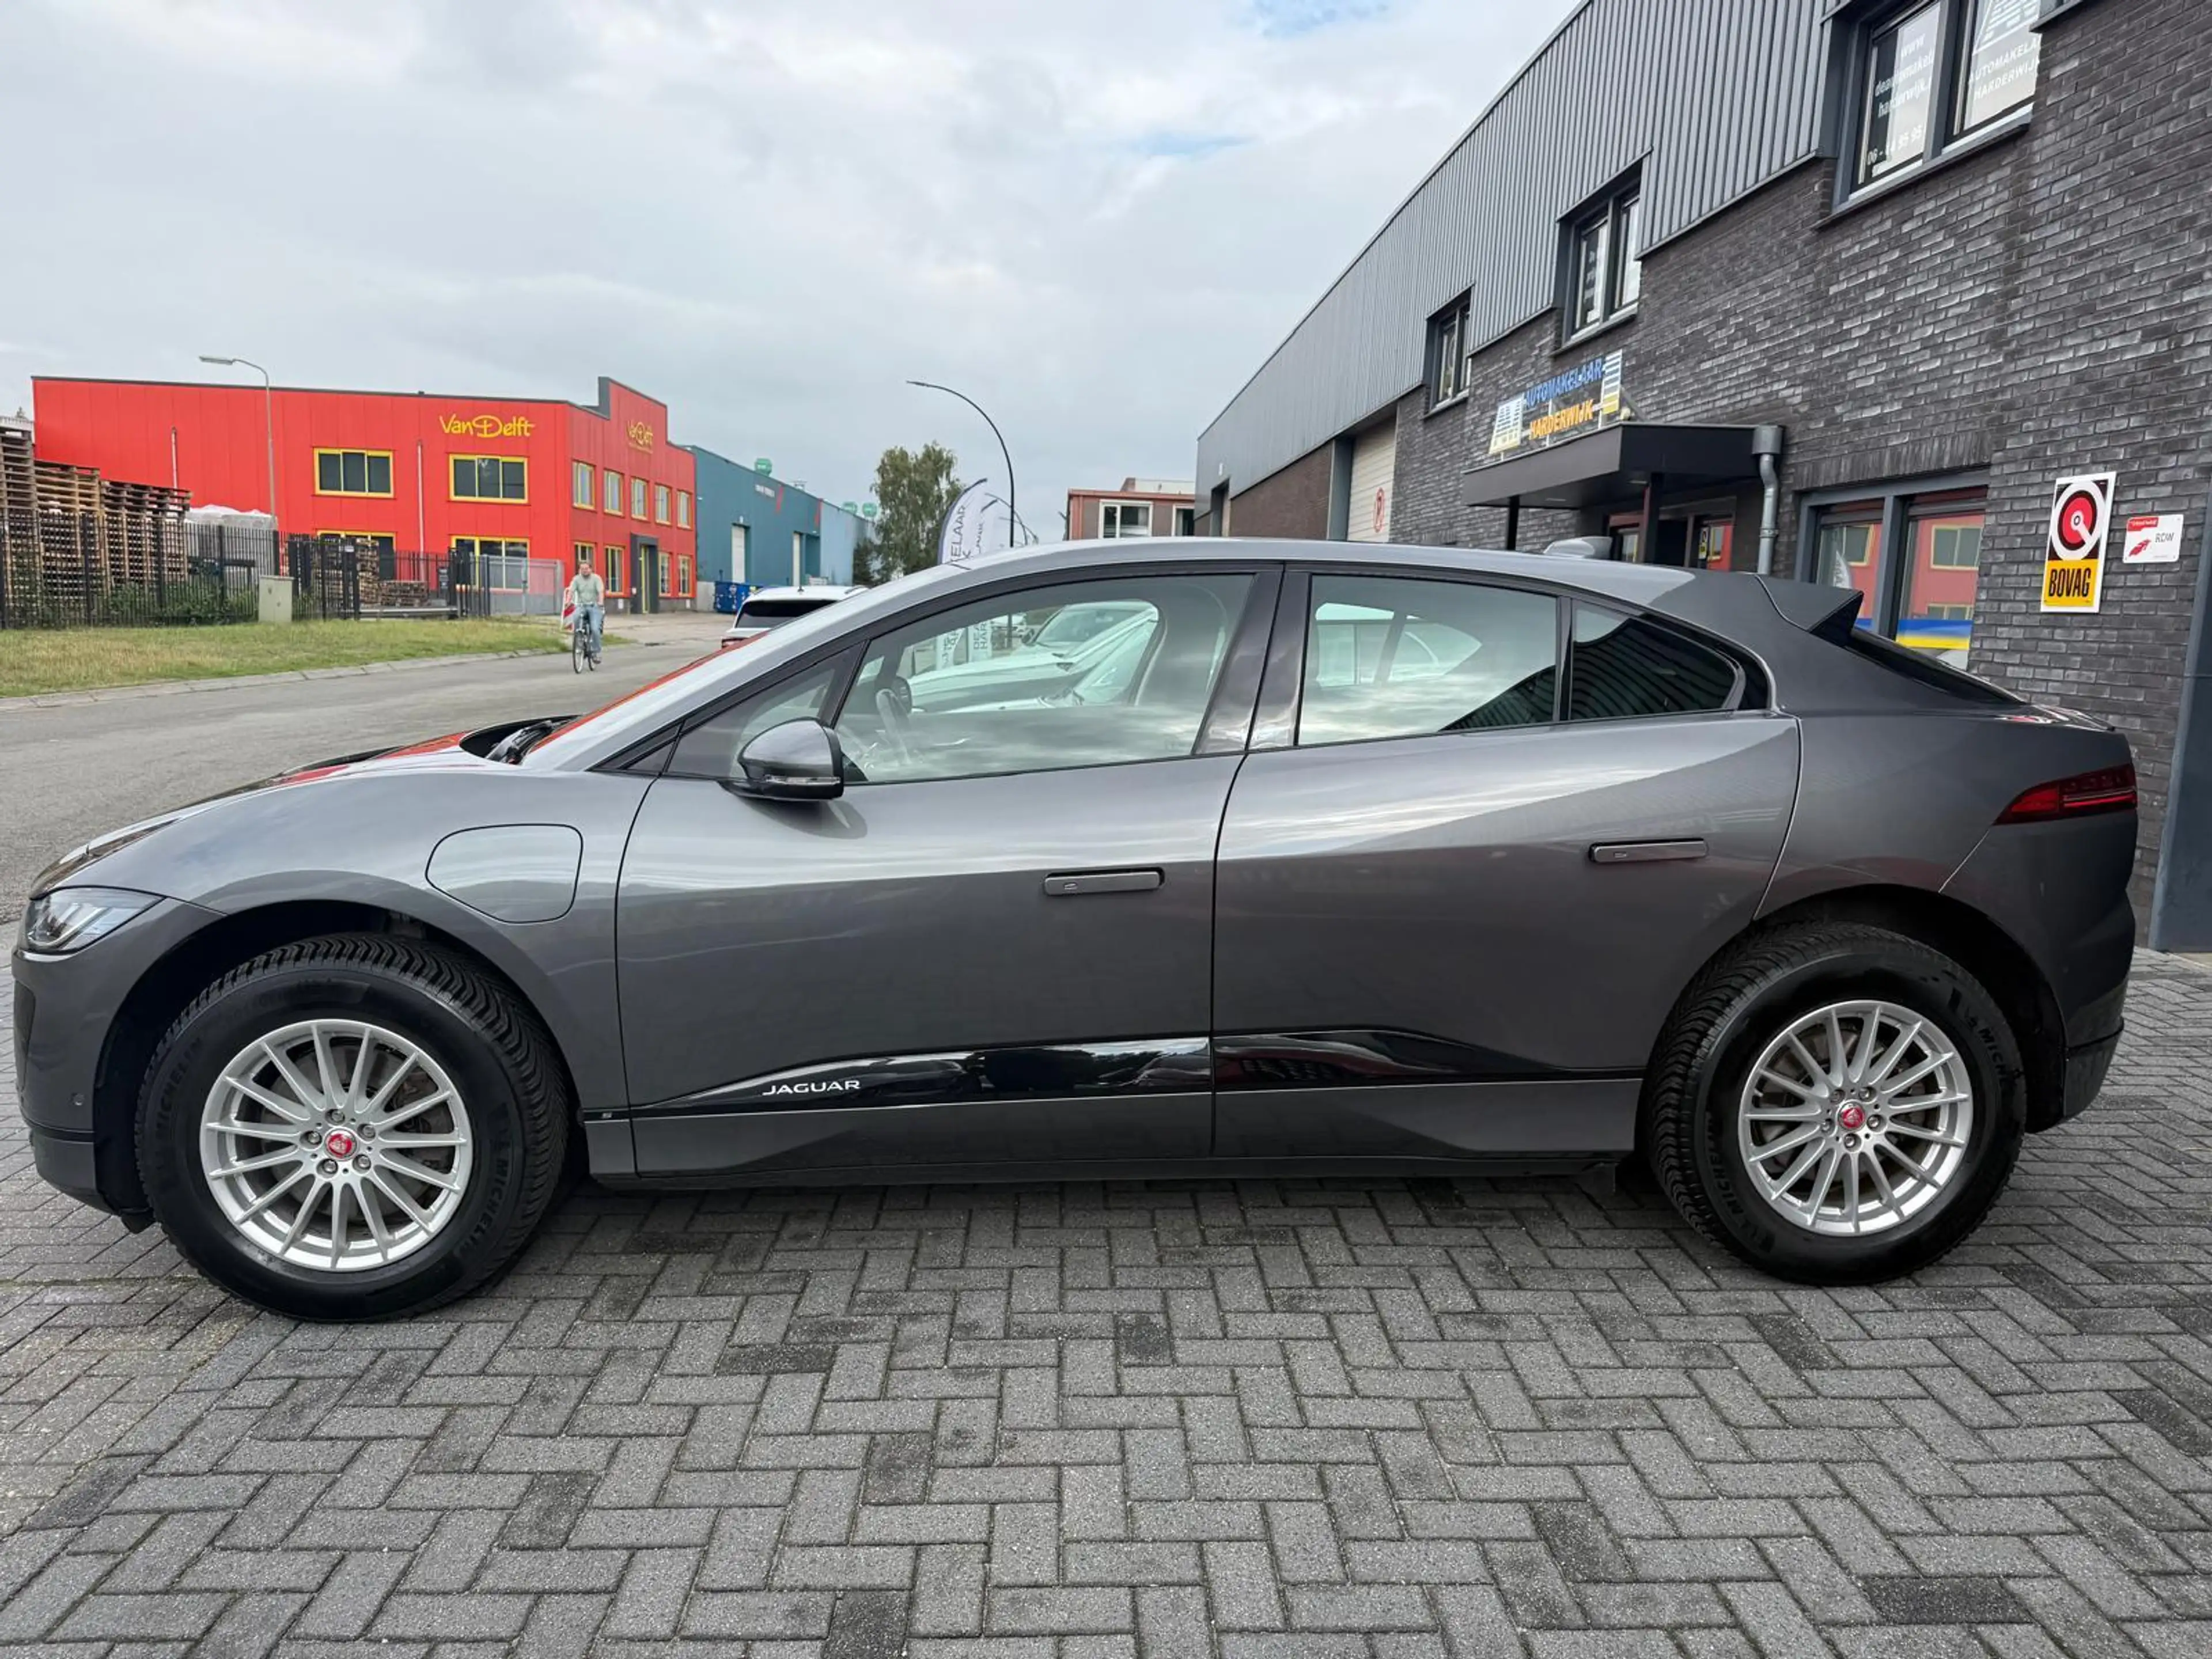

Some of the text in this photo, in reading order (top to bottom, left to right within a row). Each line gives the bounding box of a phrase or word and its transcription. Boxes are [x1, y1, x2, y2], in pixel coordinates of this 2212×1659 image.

[1969, 36, 2037, 84] AUTOMAKELA
[1974, 56, 2036, 100] HARDERWIJ
[1525, 357, 1603, 408] AUTOMAKELAAR
[1529, 399, 1594, 441] HARDERWIJK
[950, 505, 966, 562] ELAAR
[2048, 567, 2092, 597] BOVAG
[762, 1080, 861, 1096] JAGUAR
